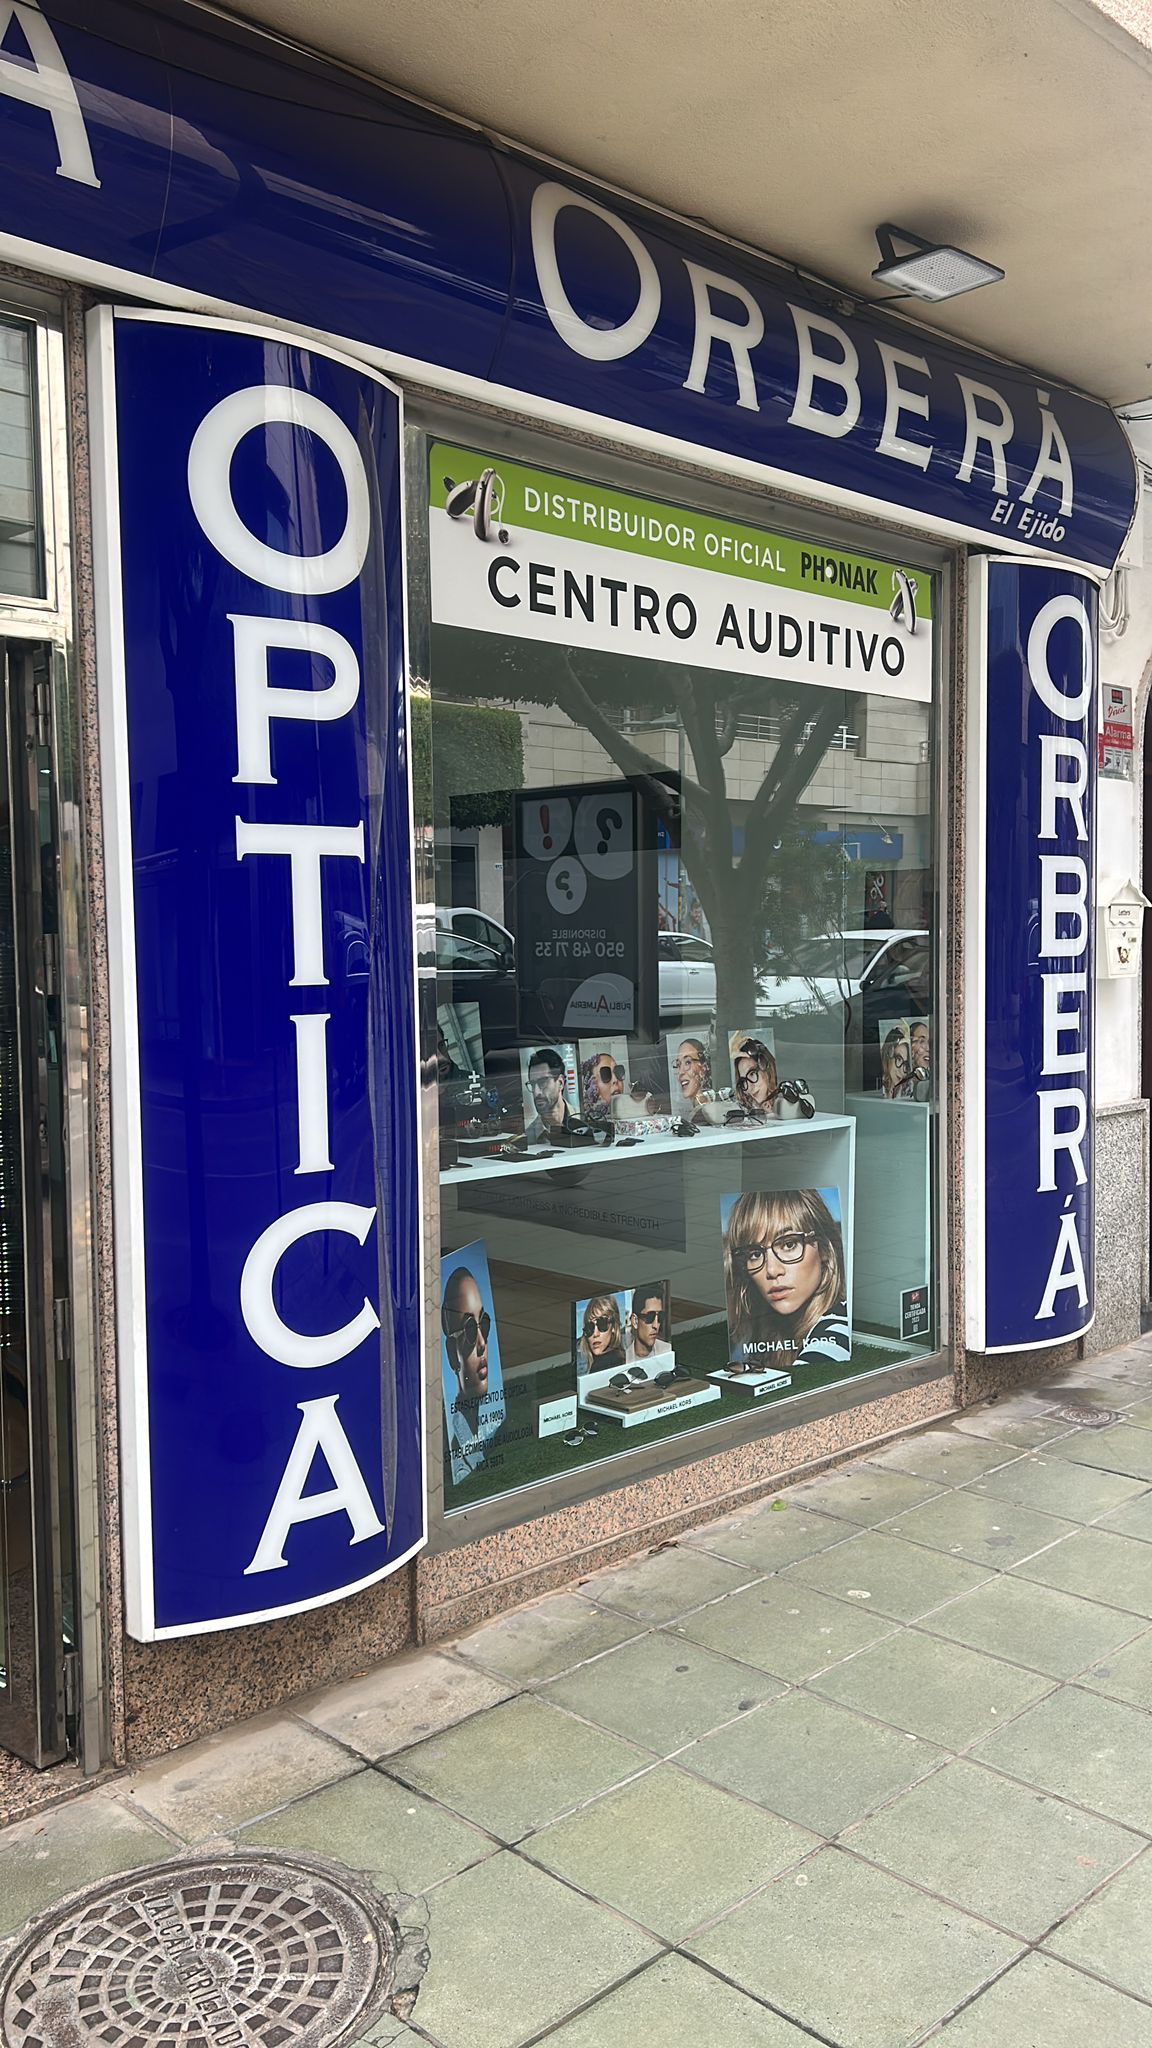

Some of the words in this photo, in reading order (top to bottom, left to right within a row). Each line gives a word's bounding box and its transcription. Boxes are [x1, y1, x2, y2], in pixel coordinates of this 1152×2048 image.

[990, 499, 1015, 525] El
[1017, 508, 1066, 542] Ejido
[524, 486, 696, 552] DISTRIBUIDOR
[704, 532, 786, 574] OFICIAL
[800, 551, 878, 595] PHONAK
[488, 555, 698, 640] CENTRO
[716, 603, 905, 677] AUDITIVO
[1105, 725, 1132, 740] Alarma
[1027, 595, 1089, 1321] ORBERÁ
[187, 384, 385, 1575] OPTICA
[610, 1213, 660, 1230] STRENGTH
[904, 1307, 926, 1319] CERTIFICADA
[742, 1339, 799, 1354] MICHAEL
[759, 1382, 777, 1393] MICHAEL
[776, 1379, 788, 1388] KORS
[657, 1403, 678, 1414] MICHAEL
[678, 1398, 692, 1408] KORS
[543, 1413, 562, 1423] MICHAEL
[562, 1410, 573, 1418] KORS
